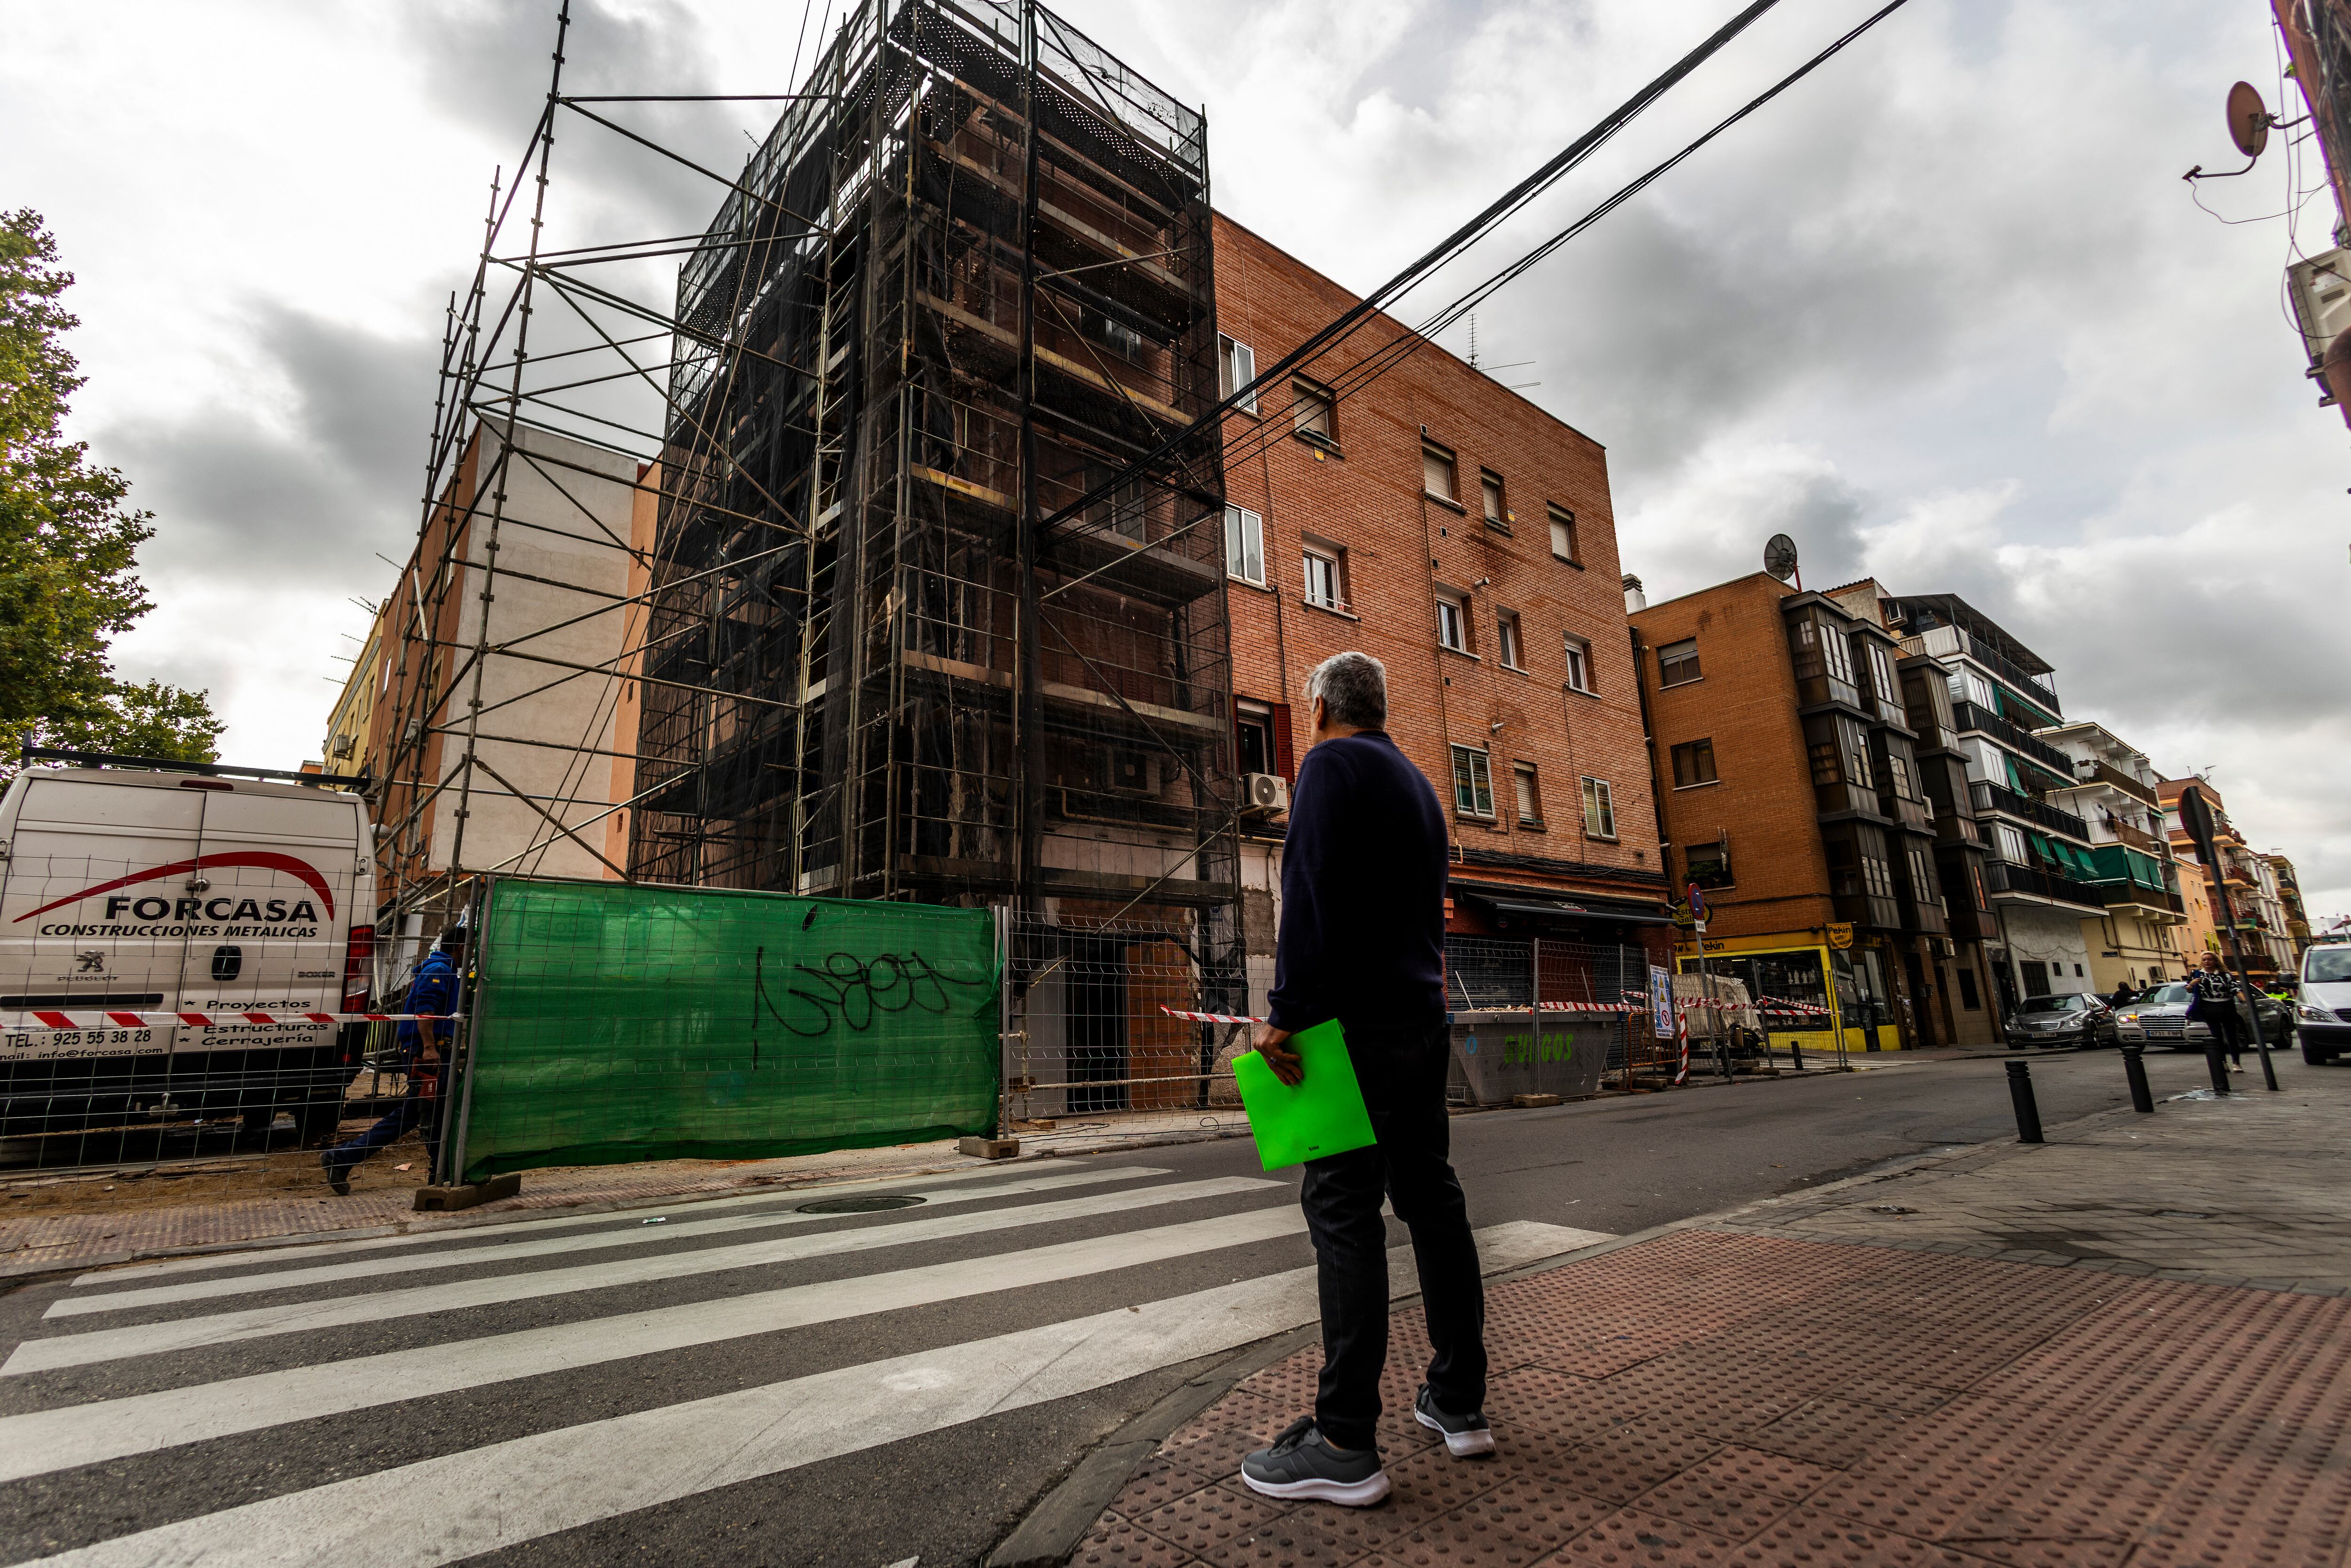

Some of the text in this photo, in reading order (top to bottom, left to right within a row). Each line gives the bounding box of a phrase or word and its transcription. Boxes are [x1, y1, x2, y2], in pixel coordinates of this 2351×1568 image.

[105, 896, 318, 922] FORCASA
[40, 924, 317, 938] CONSTRUCCIONES METALICAS
[206, 1000, 311, 1010] Proyectos
[203, 1024, 329, 1034] Estructuras
[53, 1032, 81, 1046] 925
[87, 1031, 105, 1044] 55
[111, 1031, 128, 1043] 38
[134, 1030, 151, 1042] 28
[201, 1033, 314, 1047] Cerrajería
[38, 1048, 163, 1059] info@forcasa.com
